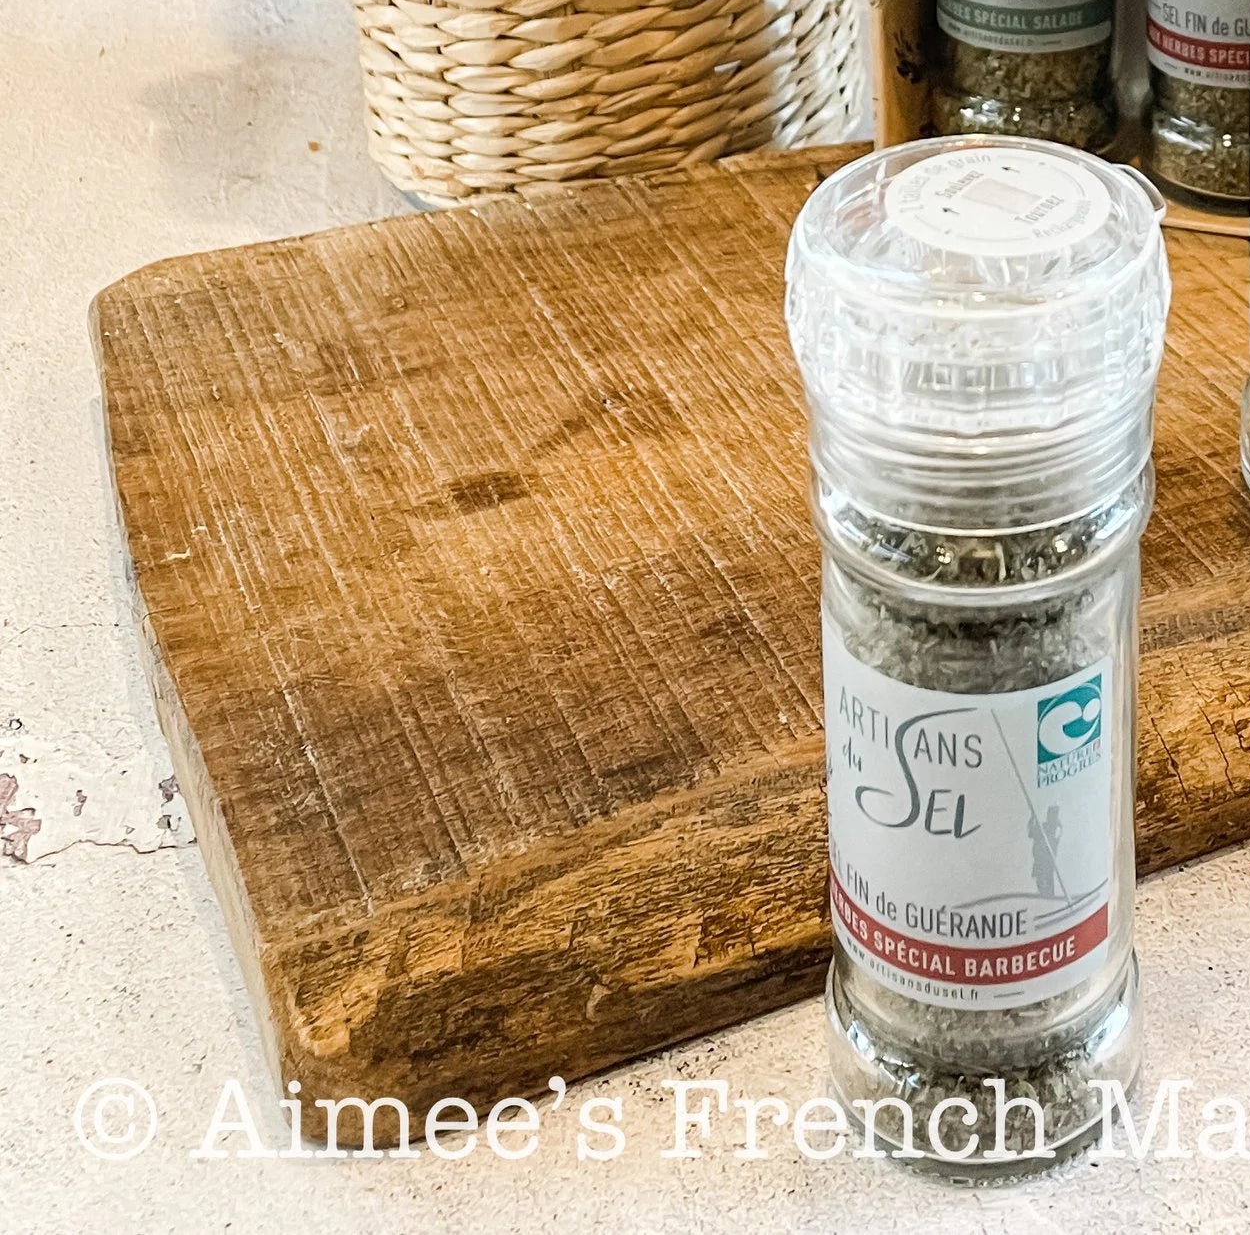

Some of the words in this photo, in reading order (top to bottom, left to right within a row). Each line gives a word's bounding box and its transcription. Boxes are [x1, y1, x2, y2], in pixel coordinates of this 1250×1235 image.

[974, 7, 1027, 29] SPÉCIAL
[1033, 12, 1083, 30] SALADE
[1163, 4, 1181, 28] SEL
[1185, 11, 1207, 35] FIN
[1212, 17, 1229, 36] de
[1209, 48, 1250, 65] SPÉCI
[1014, 194, 1065, 226] Tournez
[839, 685, 983, 769] ARTISANS
[842, 735, 863, 772] du
[846, 862, 869, 906] FIN
[875, 891, 898, 922] de
[905, 906, 1028, 940] GUÉRANDE
[873, 930, 956, 976] SPÉCIAL
[964, 935, 1077, 978] BARBECUE
